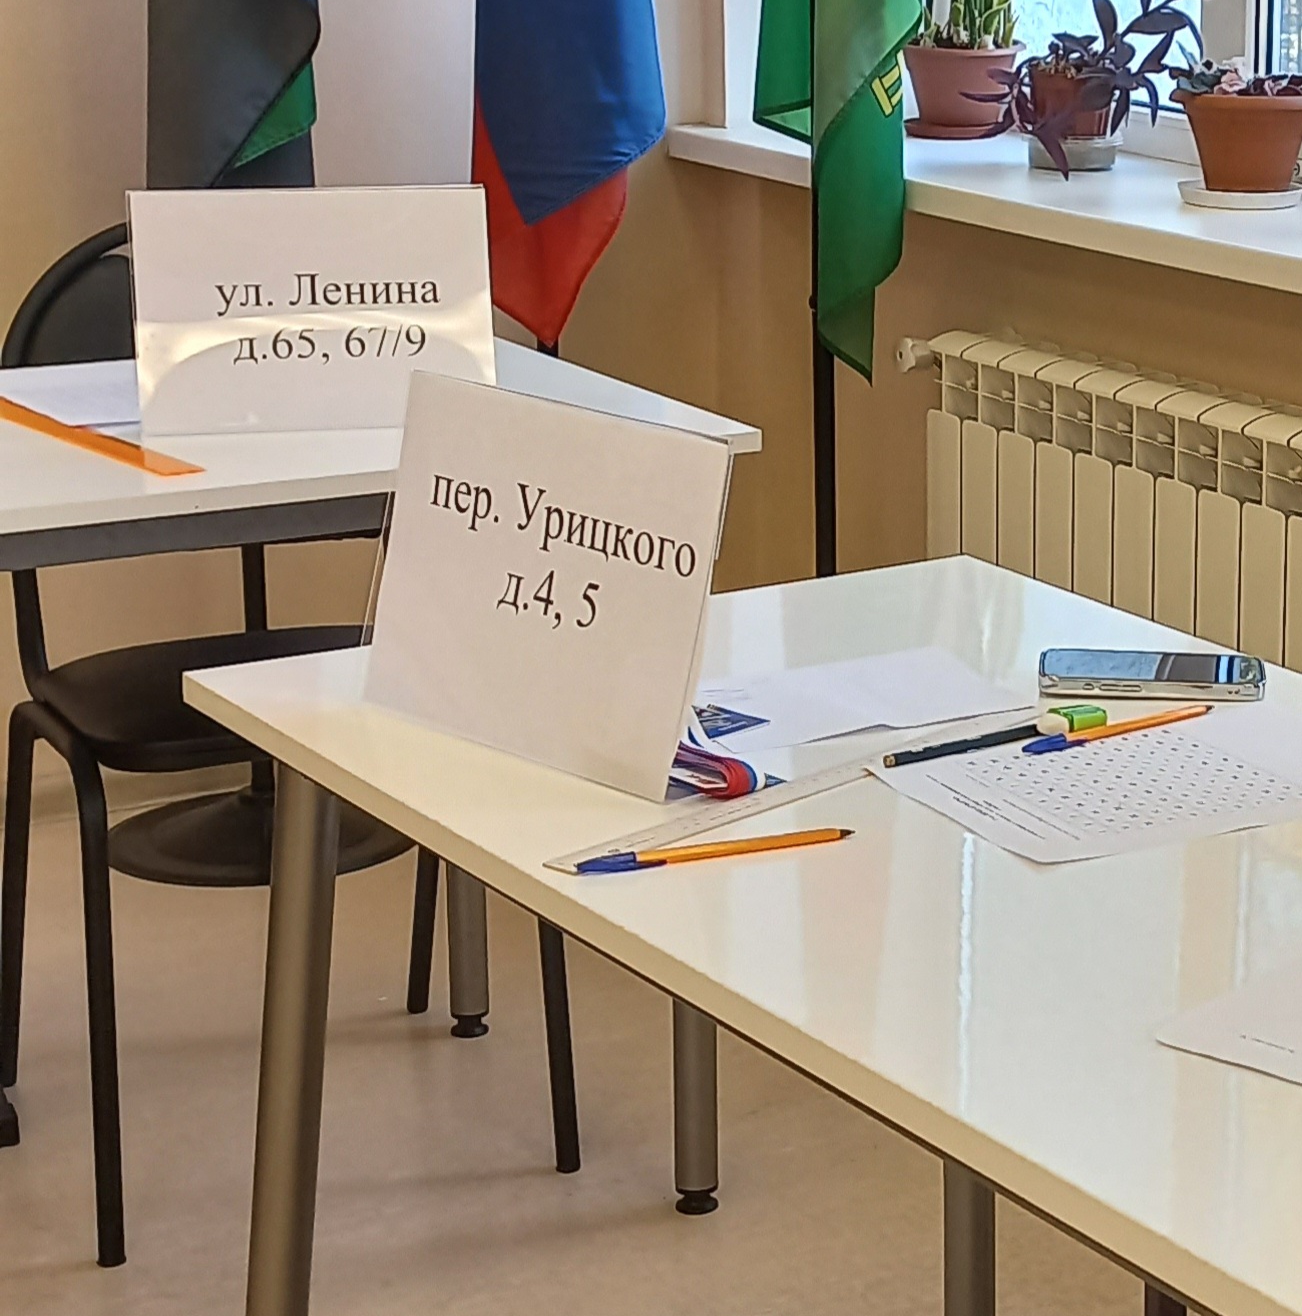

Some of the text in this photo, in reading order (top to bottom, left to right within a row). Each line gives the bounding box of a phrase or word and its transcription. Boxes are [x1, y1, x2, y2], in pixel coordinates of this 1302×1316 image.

[215, 273, 442, 318] ул. Ленина
[233, 327, 330, 366] д.65,
[430, 472, 697, 579] пер. Урицкого
[497, 570, 600, 630] д.4, 5
